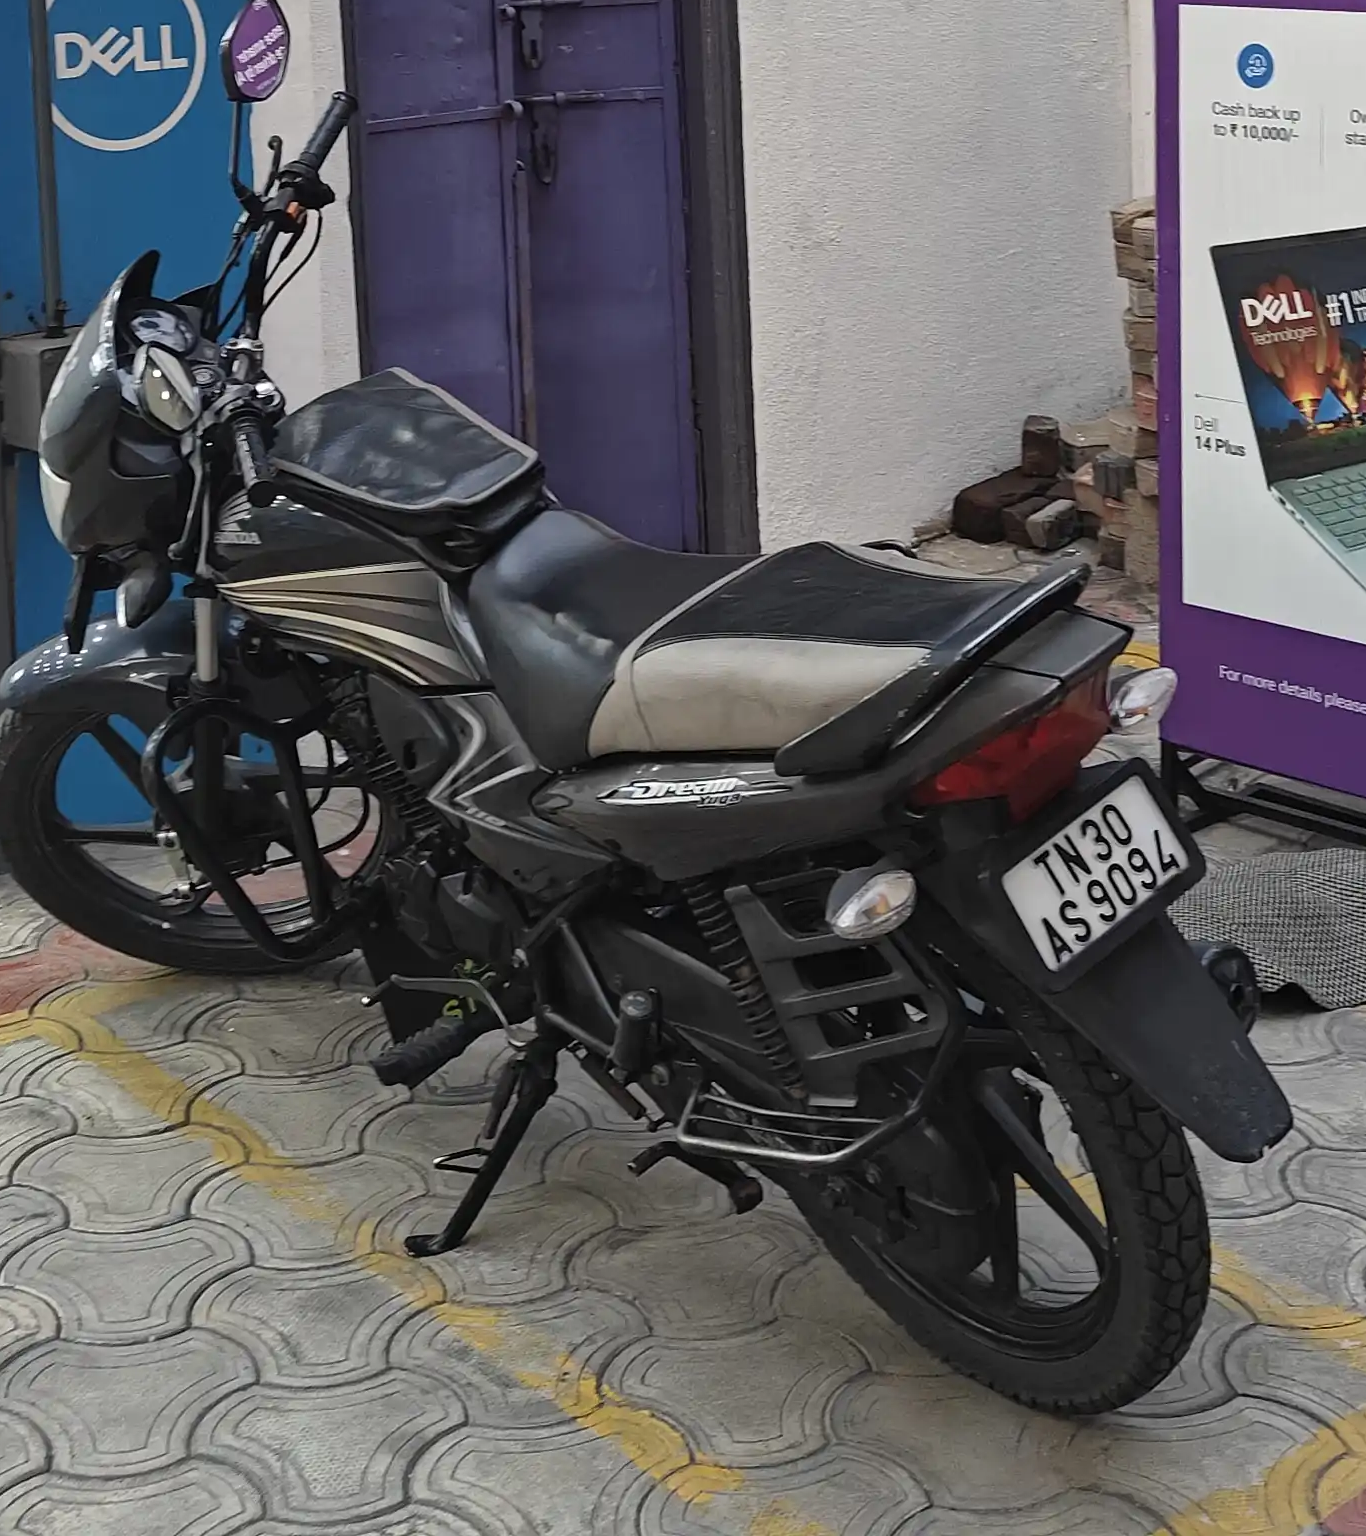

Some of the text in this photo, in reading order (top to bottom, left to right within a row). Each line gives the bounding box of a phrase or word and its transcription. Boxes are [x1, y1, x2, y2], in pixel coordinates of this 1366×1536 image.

[54, 24, 188, 80] DELL
[1212, 101, 1301, 123] Cash back up
[1213, 123, 1227, 137] to
[1241, 291, 1313, 327] DELL
[1325, 292, 1355, 326] #1
[1250, 325, 1318, 346] Technologies
[1194, 415, 1219, 433] Dell
[1195, 435, 1246, 458] 14 Plus
[1219, 664, 1240, 682] For
[1242, 673, 1277, 692] more
[1278, 680, 1322, 703] details
[631, 777, 740, 799] Dream
